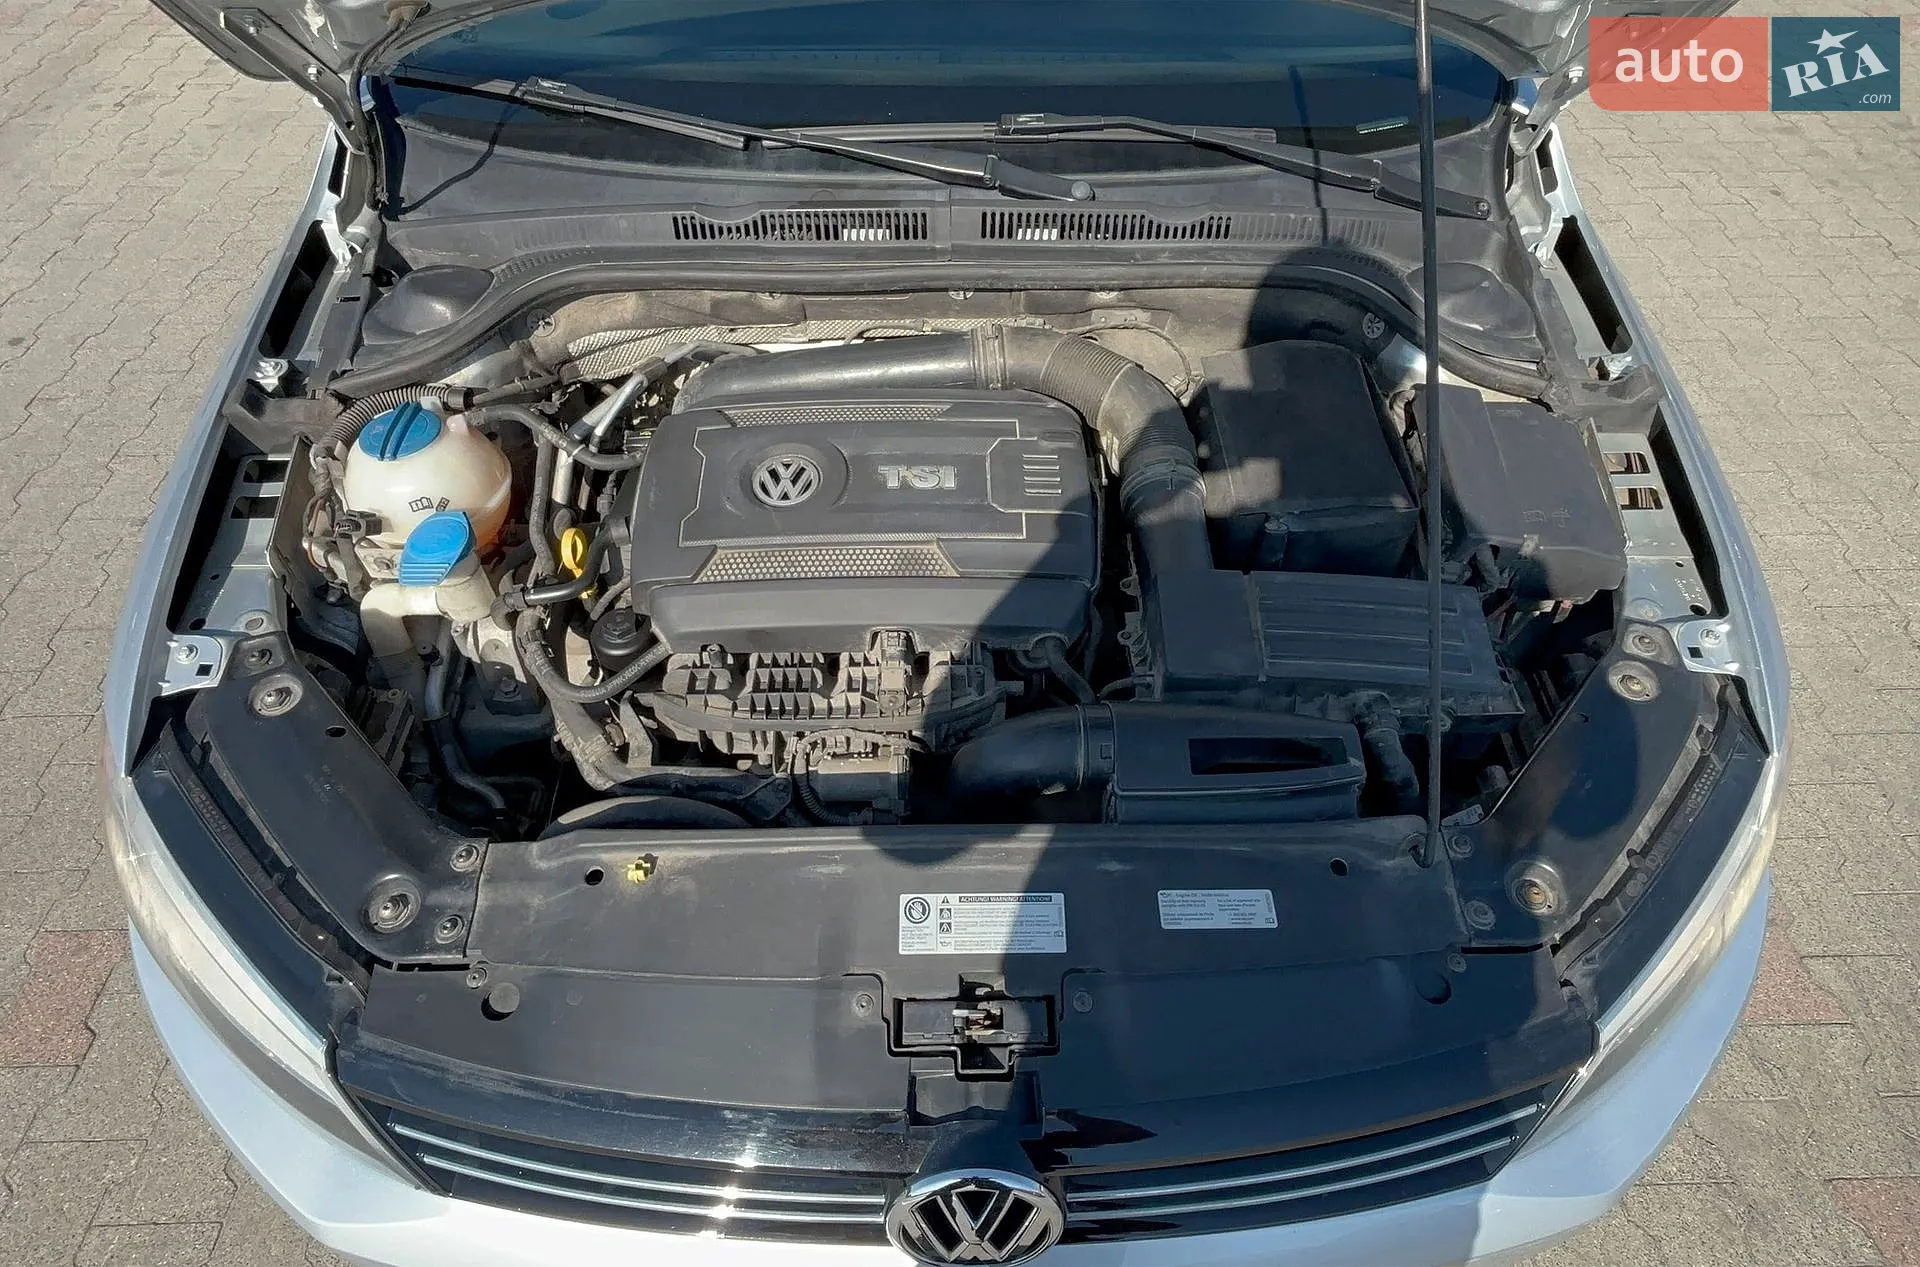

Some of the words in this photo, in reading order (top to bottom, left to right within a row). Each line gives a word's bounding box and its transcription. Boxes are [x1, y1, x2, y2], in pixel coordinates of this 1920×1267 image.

[753, 455, 821, 506] VW
[878, 465, 957, 489] TSI
[887, 1168, 1063, 1266] VW
